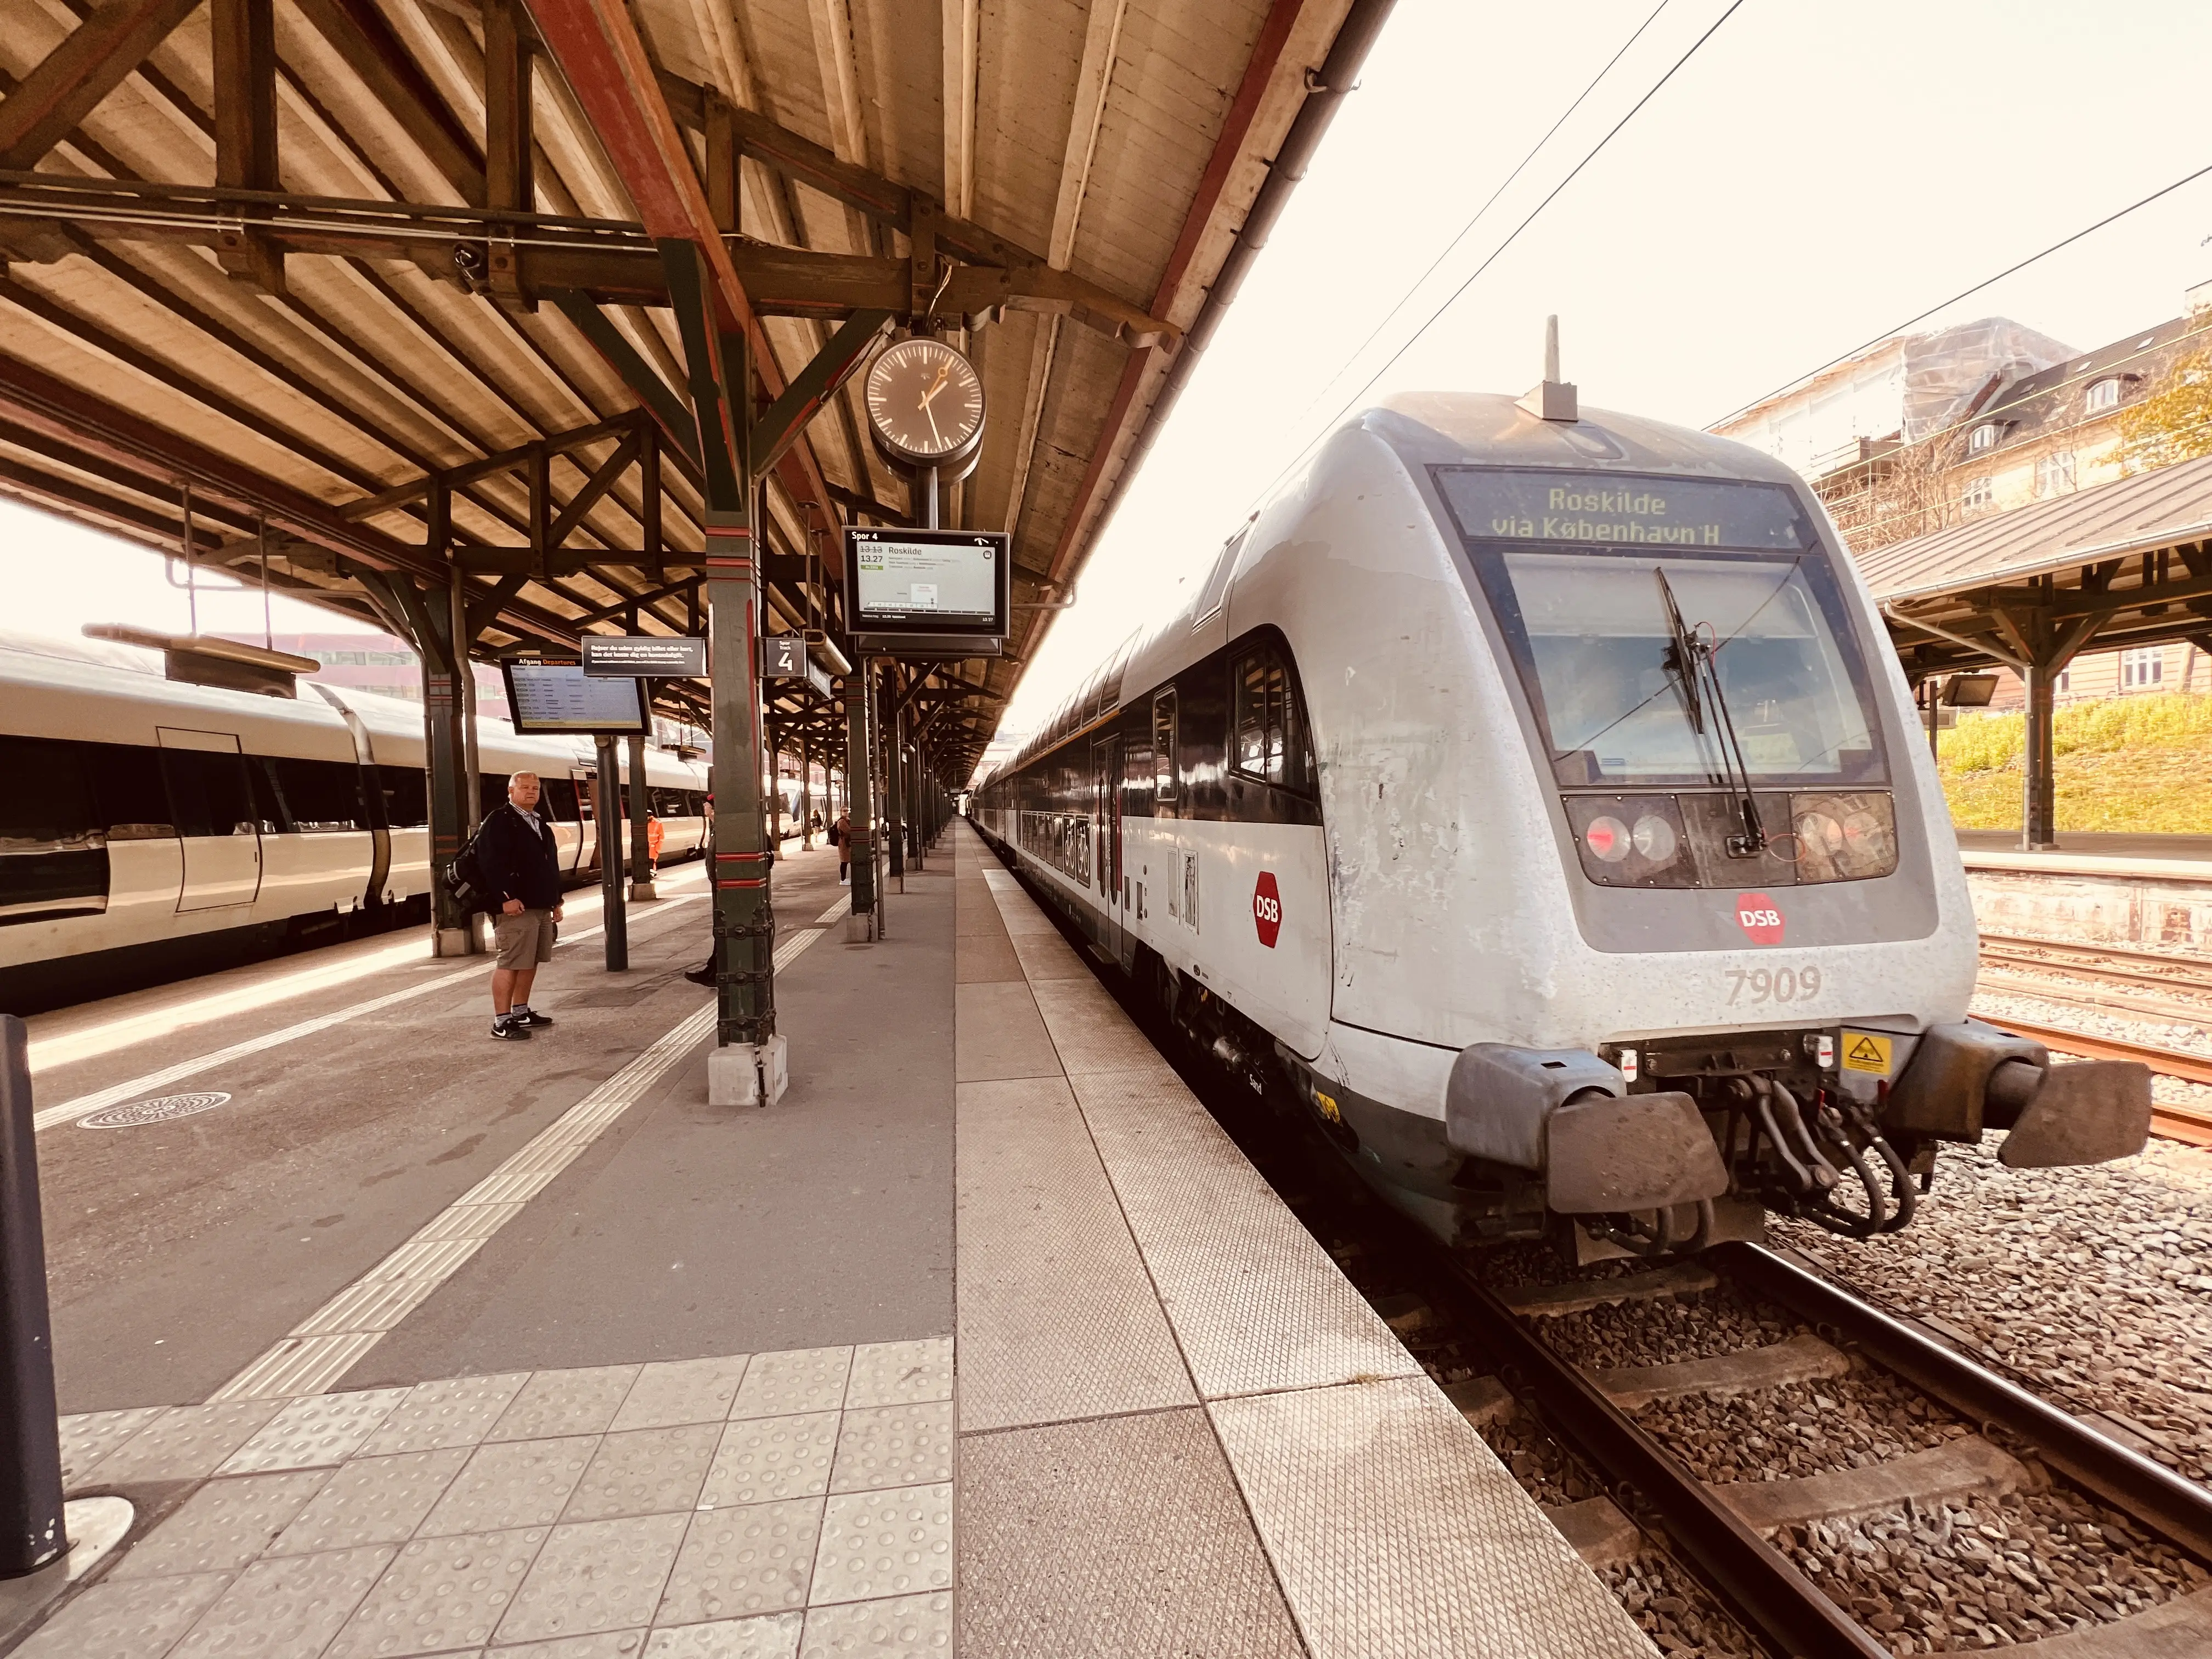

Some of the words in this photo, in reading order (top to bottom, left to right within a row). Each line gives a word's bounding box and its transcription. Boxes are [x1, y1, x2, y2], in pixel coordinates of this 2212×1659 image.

[1549, 488, 1666, 515] Roskilde
[851, 531, 870, 541] Spor
[1492, 516, 1534, 538] via
[1543, 517, 1696, 544] København
[1703, 524, 1720, 545] H
[860, 555, 883, 563] 13.27
[888, 546, 922, 555] Roskilde
[778, 652, 793, 671] 4
[1256, 895, 1279, 923] DSB
[1739, 910, 1781, 927] DSB
[1725, 966, 1821, 1006] 7909
